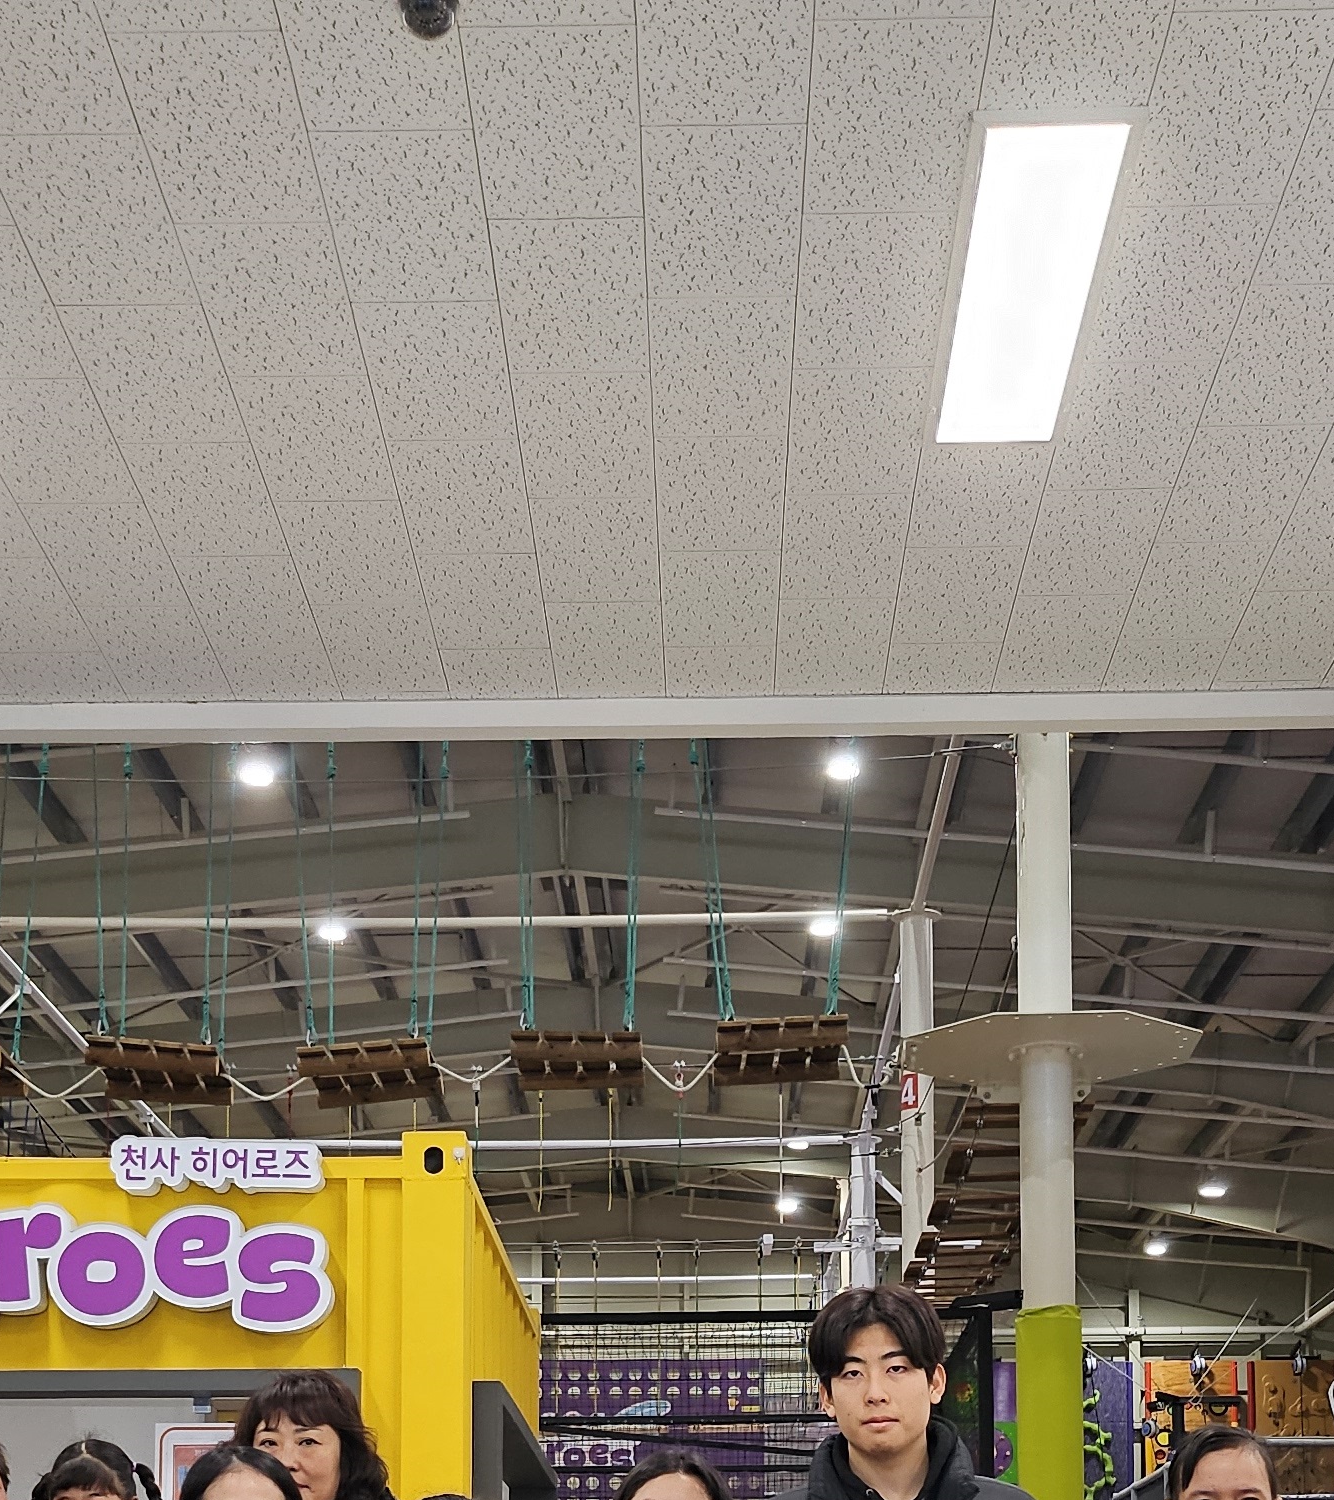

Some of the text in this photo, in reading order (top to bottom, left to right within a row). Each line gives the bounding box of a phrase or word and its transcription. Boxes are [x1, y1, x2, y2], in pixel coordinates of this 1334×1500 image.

[901, 1077, 916, 1106] 4
[120, 1144, 316, 1182] 천사 히어로즈
